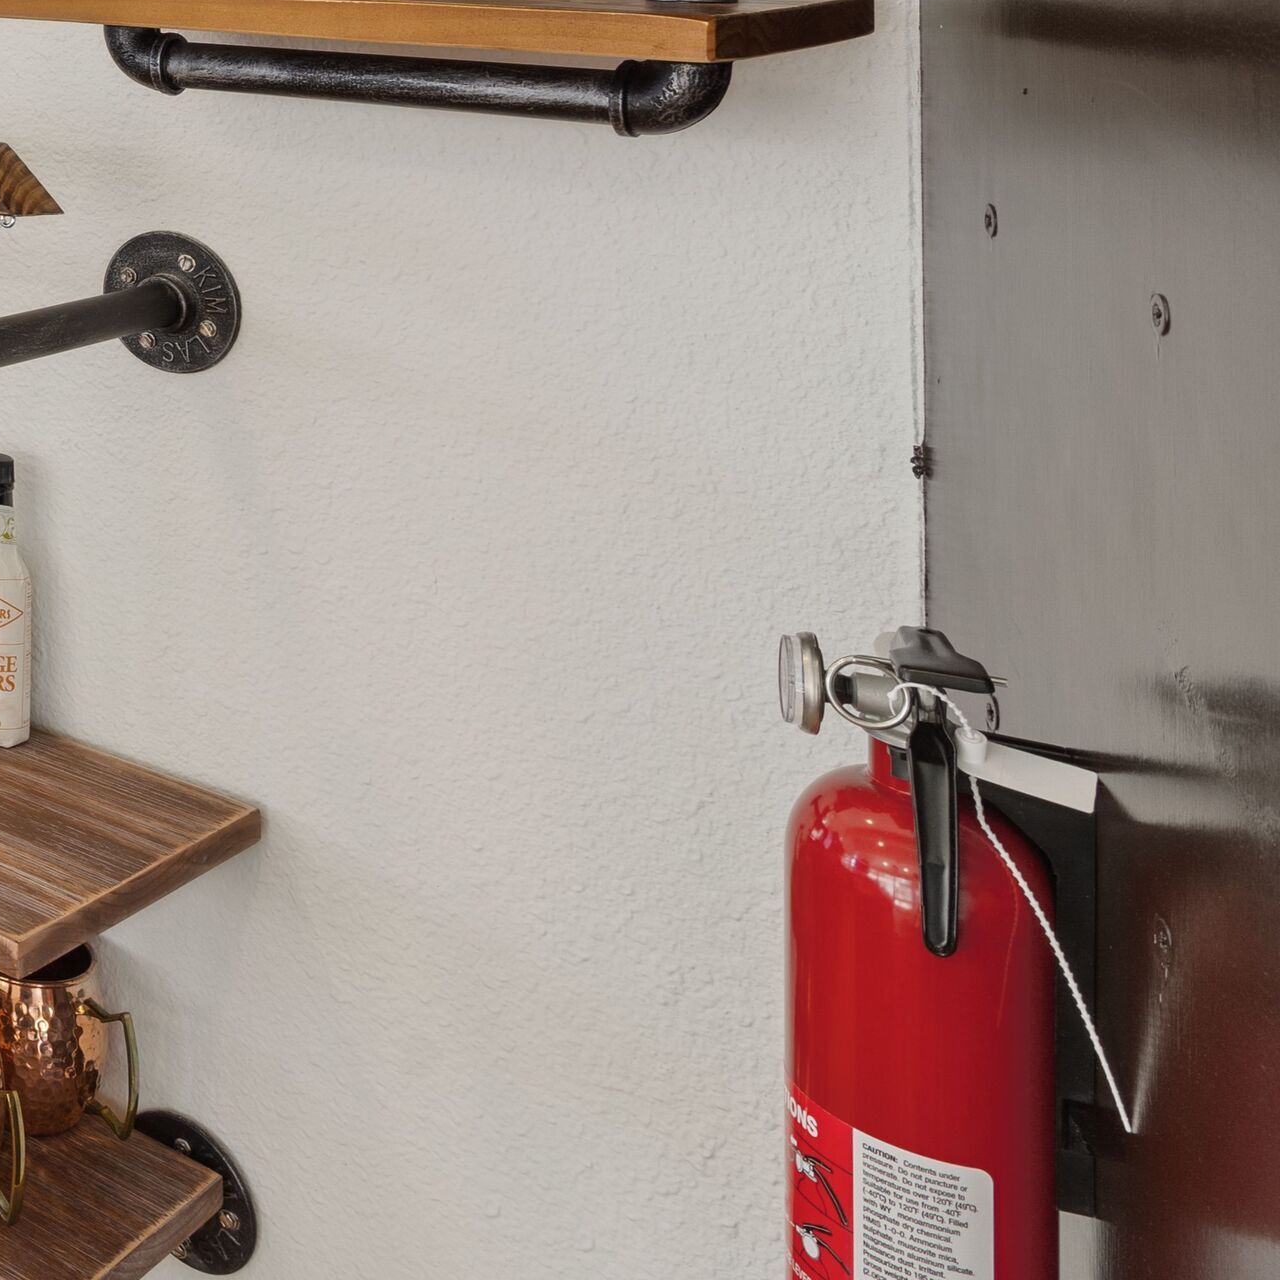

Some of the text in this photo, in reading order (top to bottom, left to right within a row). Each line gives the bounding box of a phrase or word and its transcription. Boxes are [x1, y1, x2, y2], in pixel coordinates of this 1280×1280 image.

[862, 1142, 960, 1182] CAUTION: Contents under
[862, 1169, 911, 1195] temperatures
[912, 1191, 930, 1200] over
[897, 1166, 908, 1176] Do
[910, 1172, 922, 1181] not
[924, 1177, 958, 1191] puncture
[902, 1177, 913, 1186] Do
[915, 1183, 927, 1191] not
[929, 1187, 956, 1199] expose
[958, 1193, 966, 1201] to
[862, 1177, 891, 1196] Suitable
[893, 1191, 903, 1200] for
[905, 1197, 919, 1206] use
[921, 1201, 939, 1212] from
[863, 1198, 878, 1208] with
[897, 1212, 961, 1237] monoammonium
[863, 1206, 900, 1227] phosphate
[902, 1222, 915, 1233] dry
[888, 1198, 896, 1207] to
[949, 1217, 968, 1229] Filled
[863, 1240, 895, 1261] Nuisance
[863, 1232, 905, 1255] magnesium
[907, 1252, 945, 1270] aluminum
[897, 1240, 936, 1258] muscovite
[909, 1234, 953, 1253] Ammonium
[863, 1249, 903, 1272] Pressurized
[904, 1267, 912, 1277] to
[863, 1257, 882, 1272] Gross
